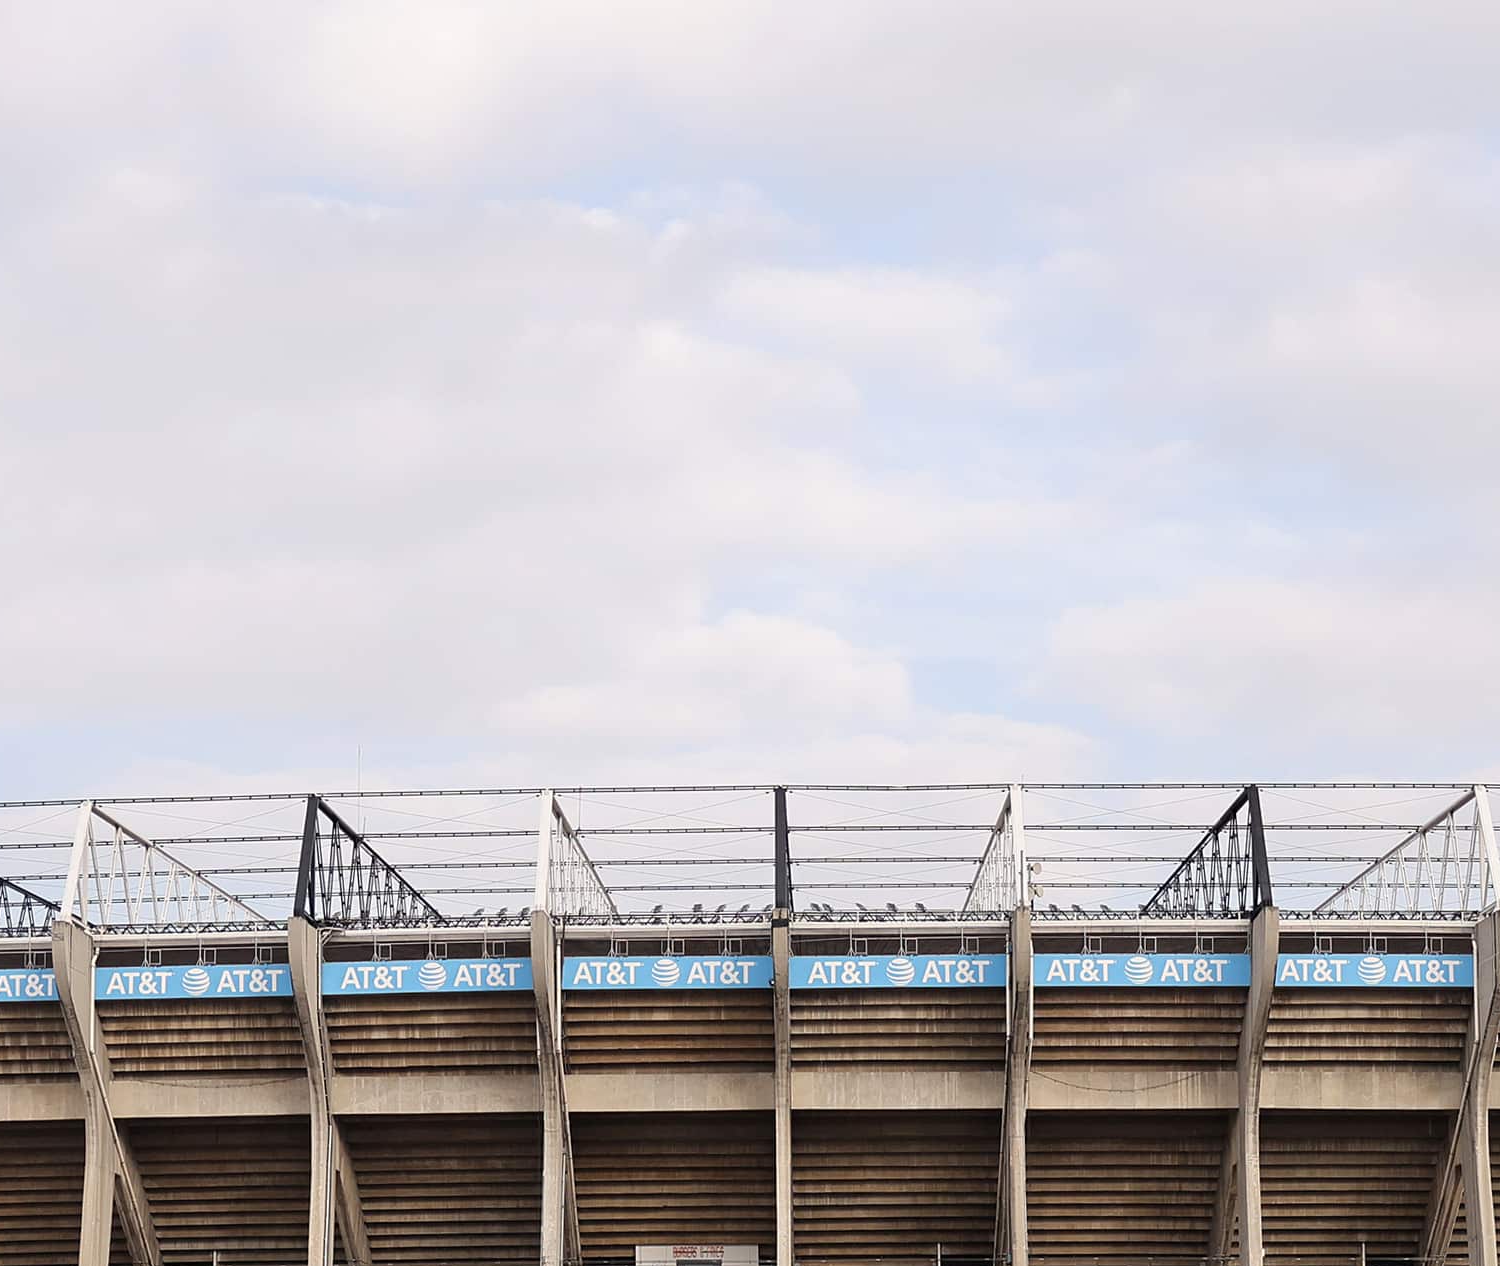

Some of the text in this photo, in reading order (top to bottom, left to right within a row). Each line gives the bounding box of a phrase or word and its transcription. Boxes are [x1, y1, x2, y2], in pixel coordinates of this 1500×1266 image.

[106, 968, 284, 996] AT&T AT&T
[340, 963, 521, 989] AT&T AT&T
[573, 960, 756, 987] AT&T AT&T
[807, 960, 990, 986] AT&T AT&T
[1046, 958, 1228, 984] AT&T AT&T
[1279, 959, 1460, 985] AT&T AT&T
